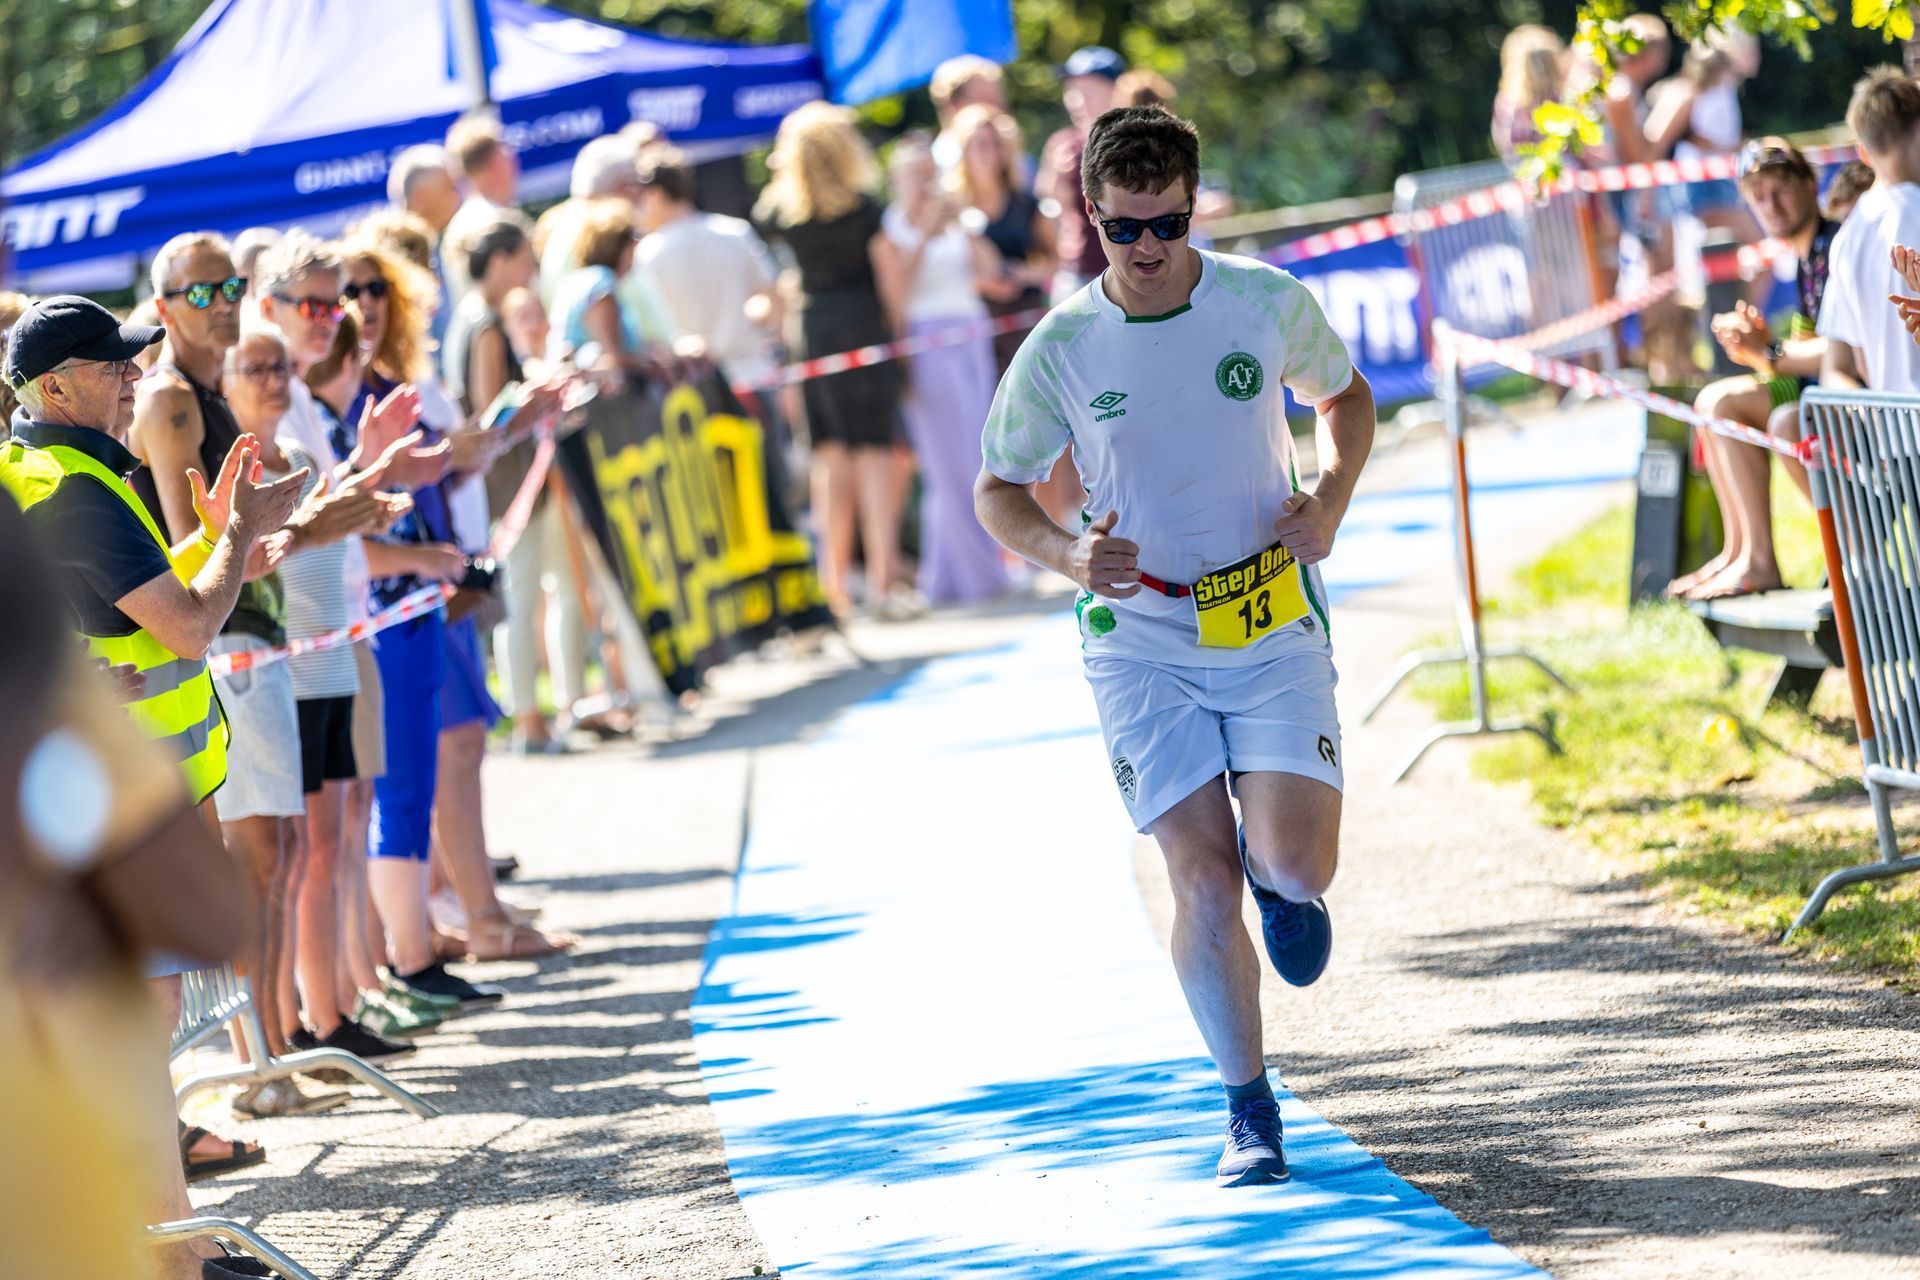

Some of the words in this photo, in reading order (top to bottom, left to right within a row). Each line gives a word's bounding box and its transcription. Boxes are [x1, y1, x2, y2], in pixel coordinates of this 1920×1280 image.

[1095, 407, 1126, 423] umbro
[1196, 564, 1256, 602] Step
[1198, 595, 1231, 610] TRIATHLON
[1238, 589, 1273, 640] 13
